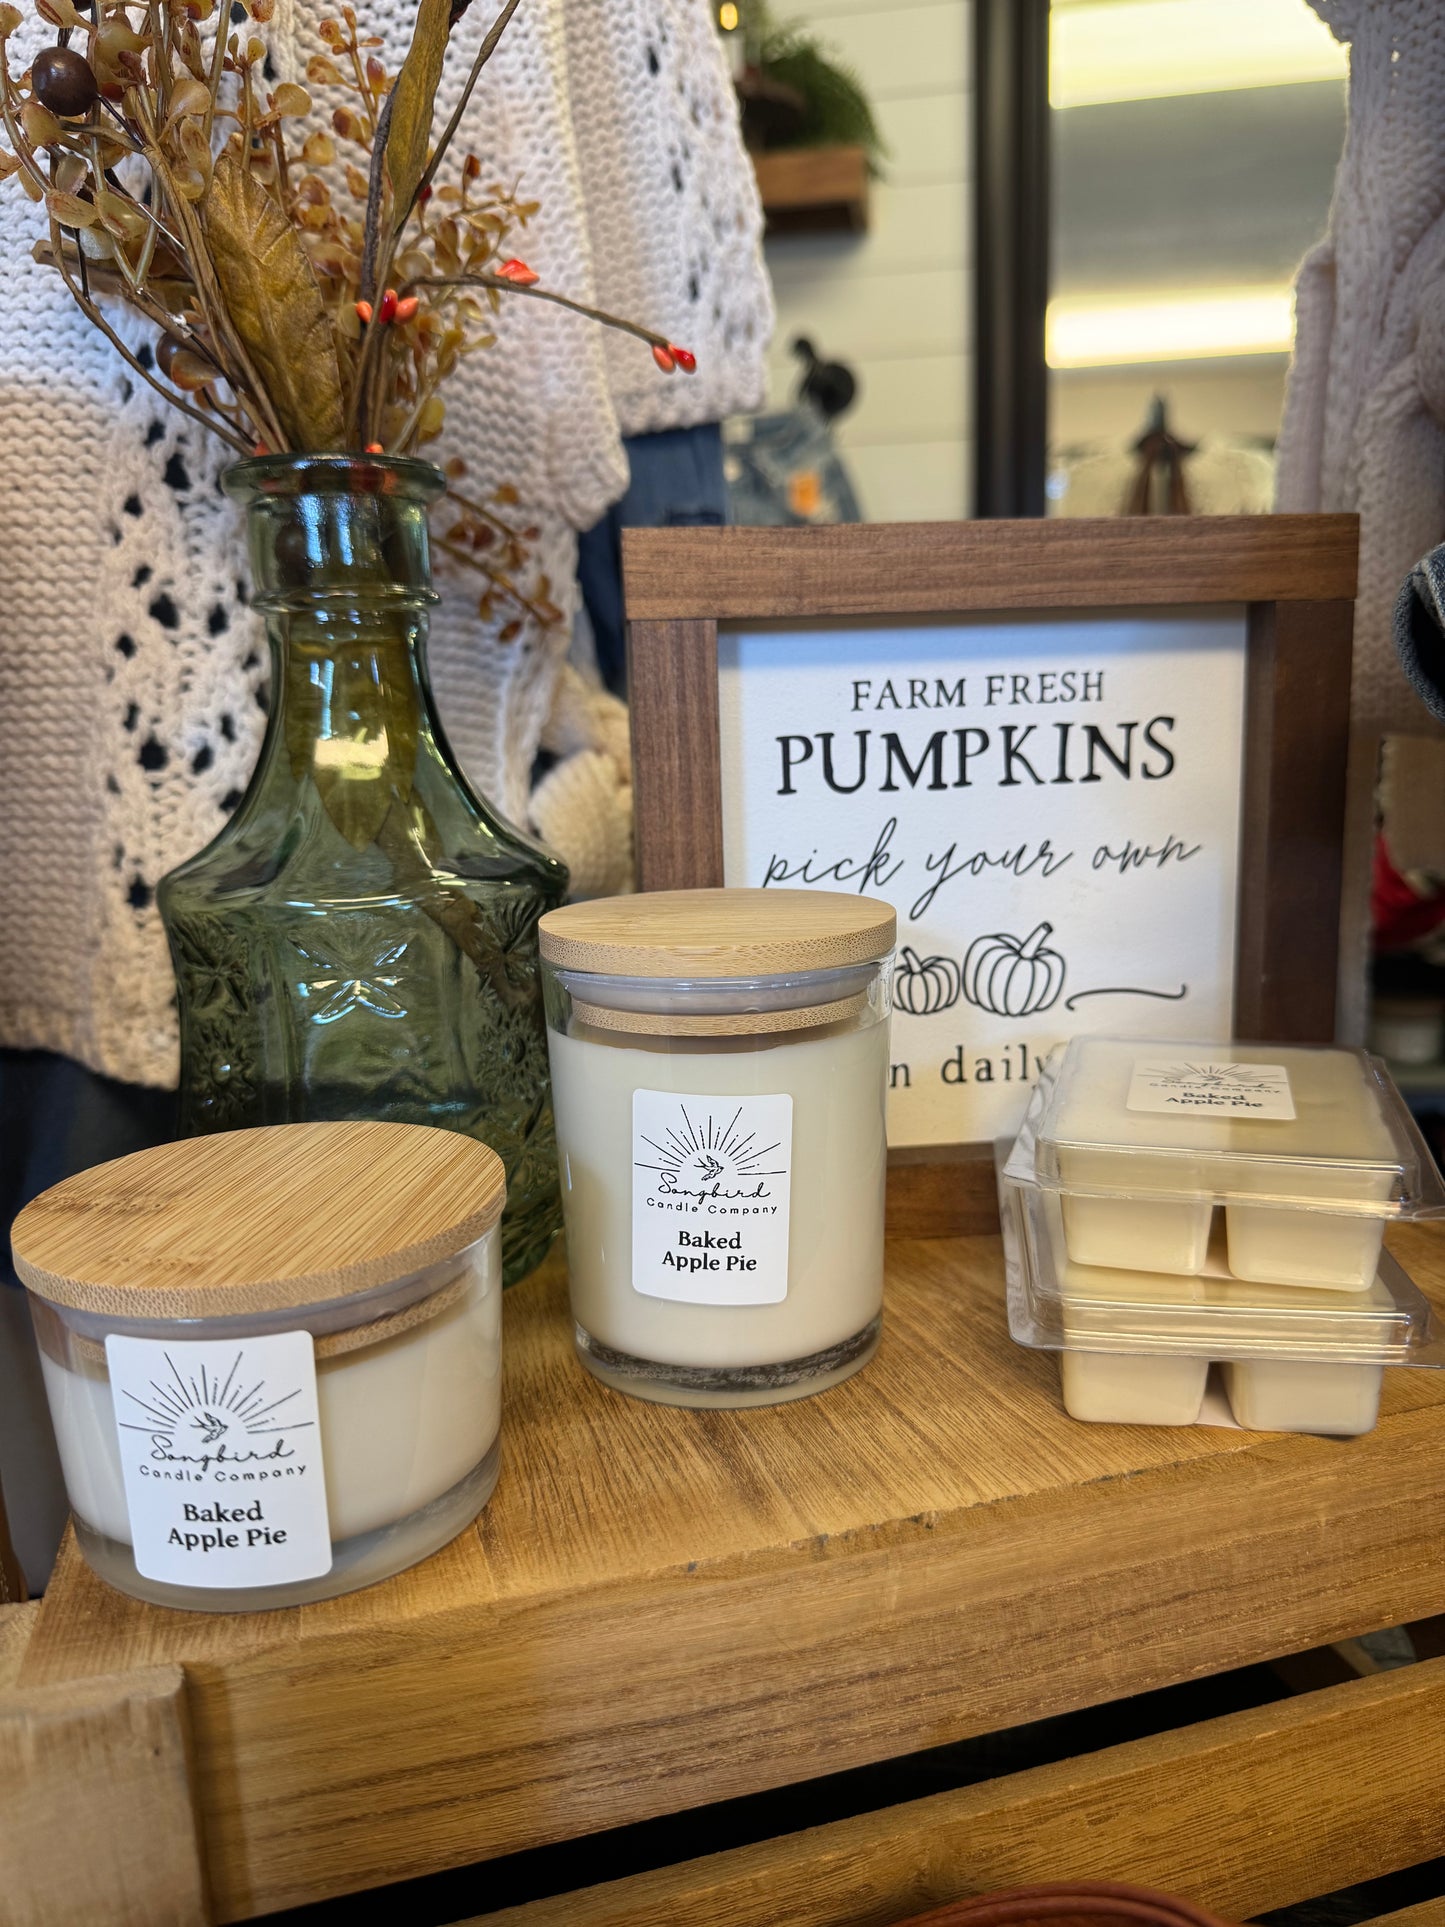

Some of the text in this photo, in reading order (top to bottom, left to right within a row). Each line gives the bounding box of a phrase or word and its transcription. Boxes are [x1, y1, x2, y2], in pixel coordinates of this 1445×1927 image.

[851, 671, 1104, 711] FARM FRESH
[776, 716, 1175, 795] PUMPKINS
[762, 817, 1202, 920] pick your own
[1166, 1097, 1263, 1108] Apple Pie
[1183, 1092, 1246, 1100] Baked
[658, 1172, 771, 1205] Songbird
[646, 1197, 778, 1216] Candle Company
[678, 1230, 742, 1250] Baked
[662, 1250, 757, 1273] Apple Pie
[150, 1434, 295, 1472] Songbird
[139, 1464, 307, 1482] Candle Company
[183, 1500, 264, 1523] Baked
[167, 1527, 288, 1552] Apple Pie
